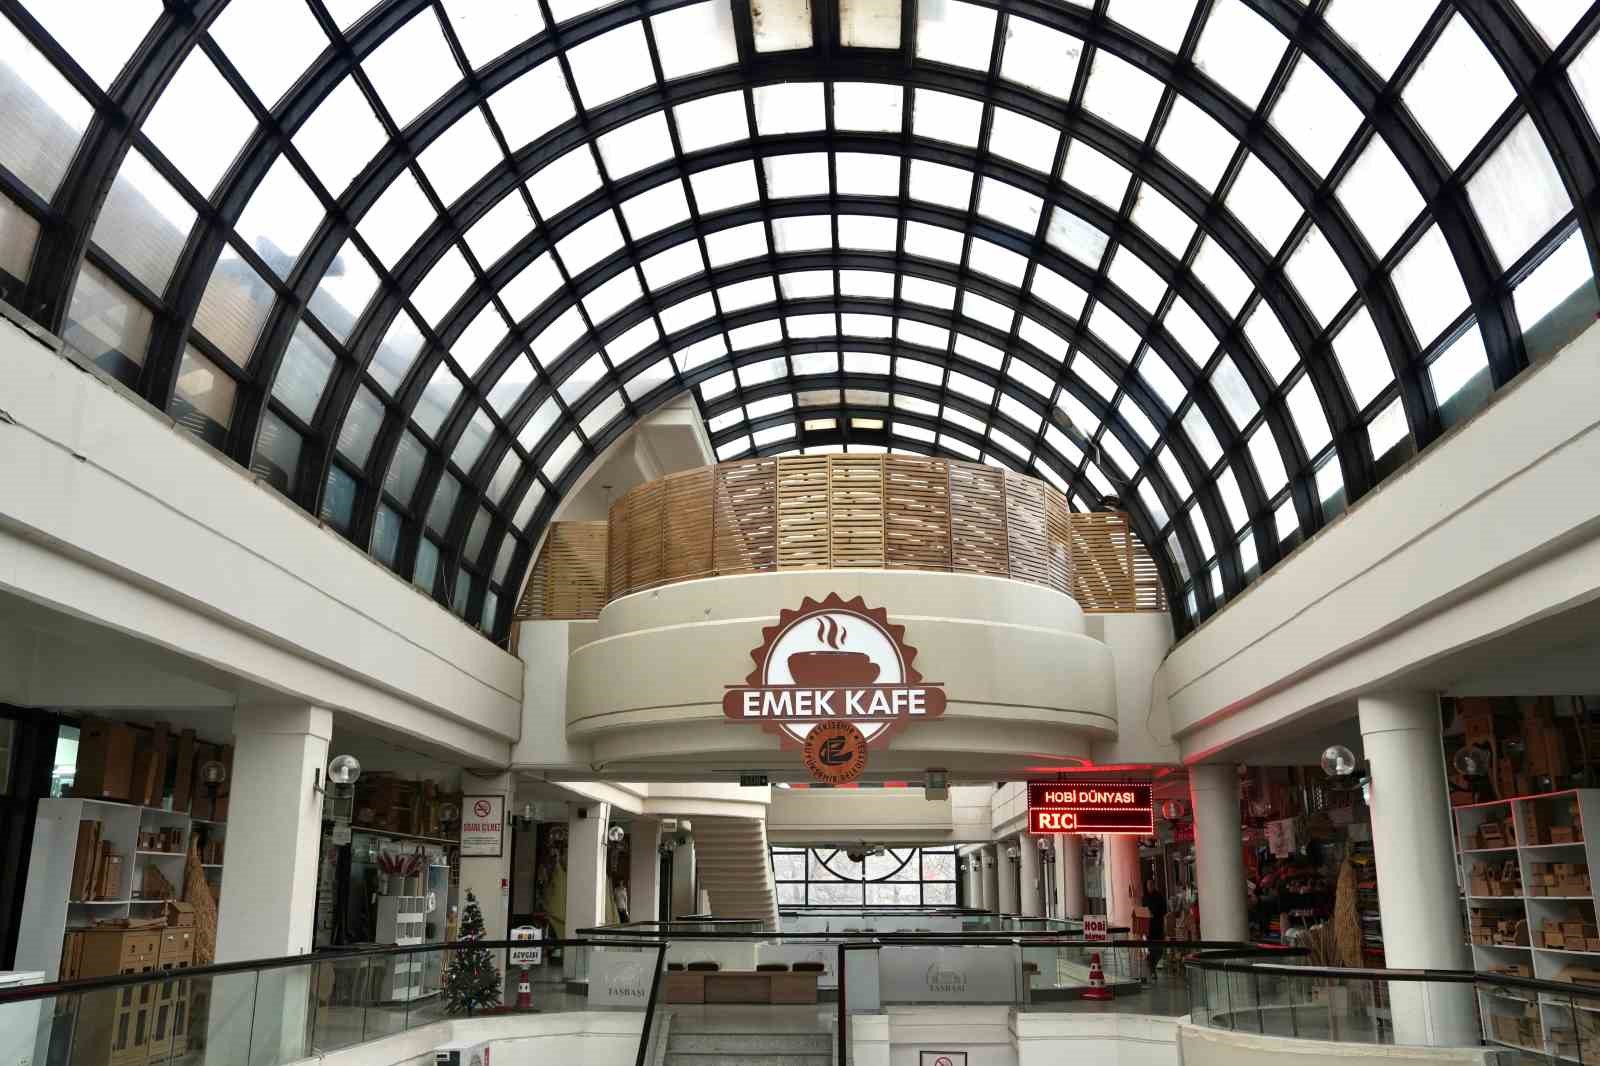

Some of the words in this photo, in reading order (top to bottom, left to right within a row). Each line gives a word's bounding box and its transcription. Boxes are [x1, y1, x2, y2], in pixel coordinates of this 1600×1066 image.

[743, 690, 835, 717] EMEK
[846, 690, 927, 716] KAFE
[1045, 789, 1077, 803] HOBİ
[1079, 789, 1135, 804] DÜNYASI
